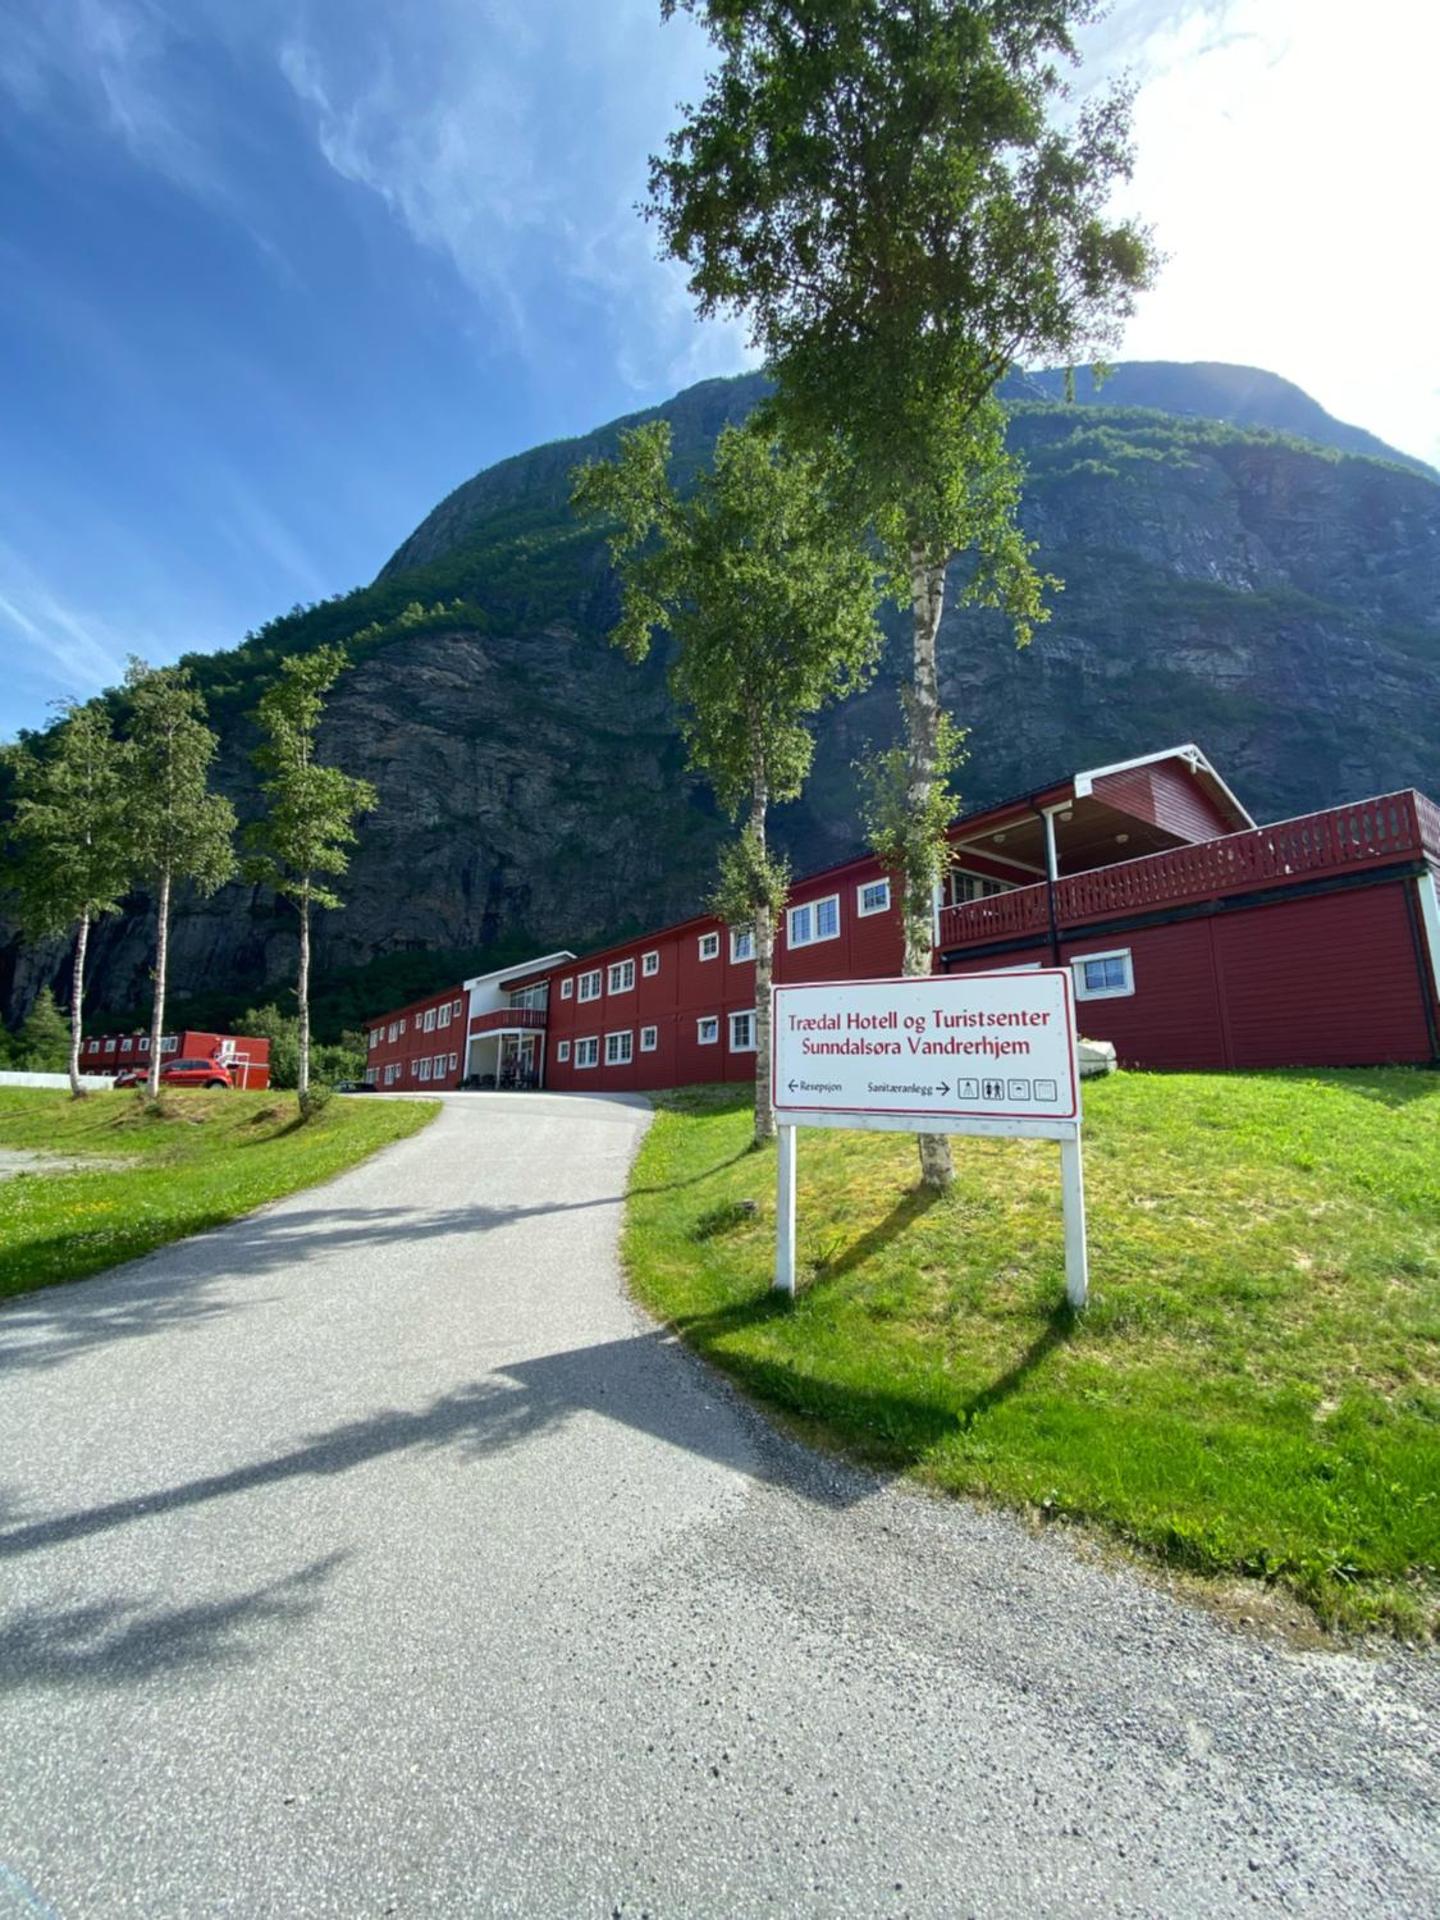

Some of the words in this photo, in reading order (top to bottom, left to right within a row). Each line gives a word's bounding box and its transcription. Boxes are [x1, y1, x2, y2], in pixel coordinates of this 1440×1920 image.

[788, 1013, 841, 1031] Trædal
[847, 1011, 898, 1029] Hotell
[903, 1016, 926, 1033] og
[932, 1009, 1050, 1027] Turistsenter
[802, 1037, 901, 1055] Sunndalsøra
[907, 1036, 1030, 1059] Vandrerhjem
[799, 1080, 842, 1092] Resepsjon
[868, 1082, 933, 1096] Sanitæranlegg
